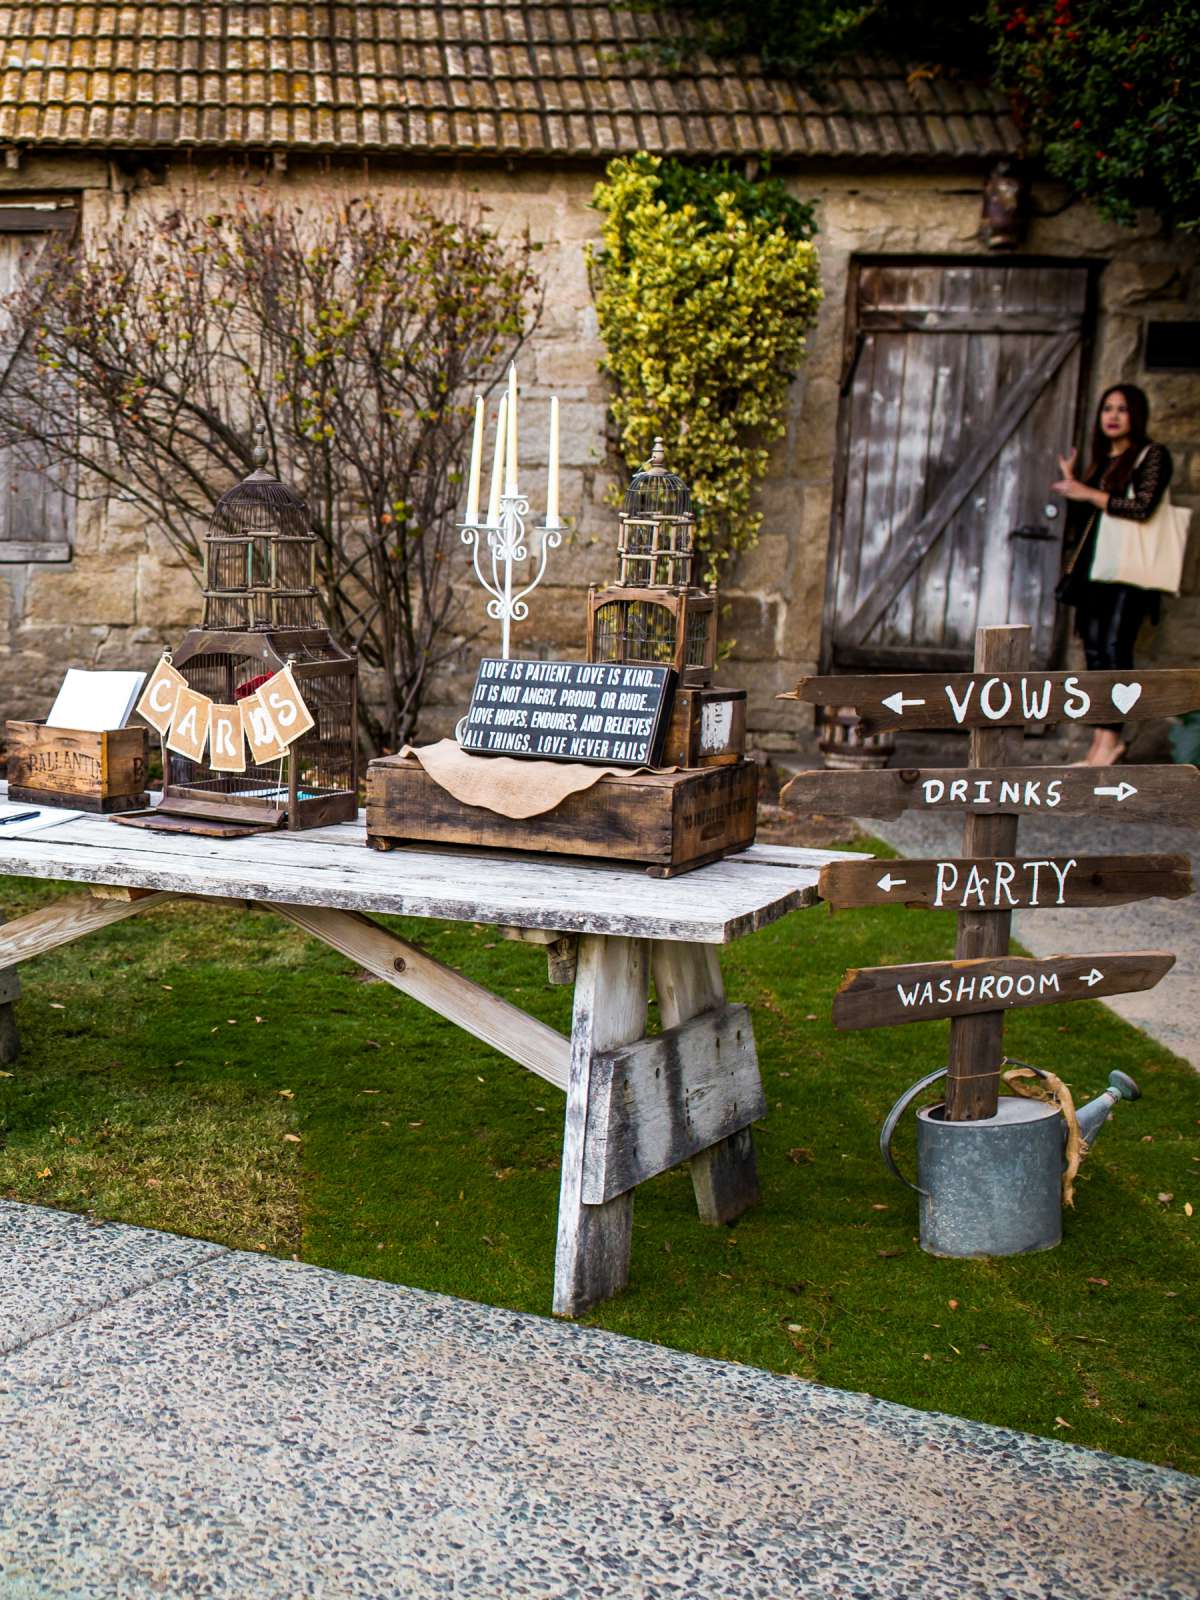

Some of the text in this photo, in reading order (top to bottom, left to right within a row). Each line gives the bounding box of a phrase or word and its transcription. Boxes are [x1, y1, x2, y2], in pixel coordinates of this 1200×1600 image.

[481, 661, 661, 688] LOVE IS PATIENT, LOVE IS KIND...
[475, 684, 655, 712] IT IS NOT ANGRY, PROUD, OR RUDE...
[944, 677, 1091, 724] VOWS
[149, 678, 298, 757] CARDS
[470, 707, 653, 736] LOVE HOPES, ENDURES, AND BELIEVES
[464, 730, 647, 760] ALL THINGS, LOVE NEVER FAILS
[922, 779, 1062, 807] DRINKS
[933, 858, 1077, 908] PARTY
[897, 973, 1060, 1008] WASHROOM
